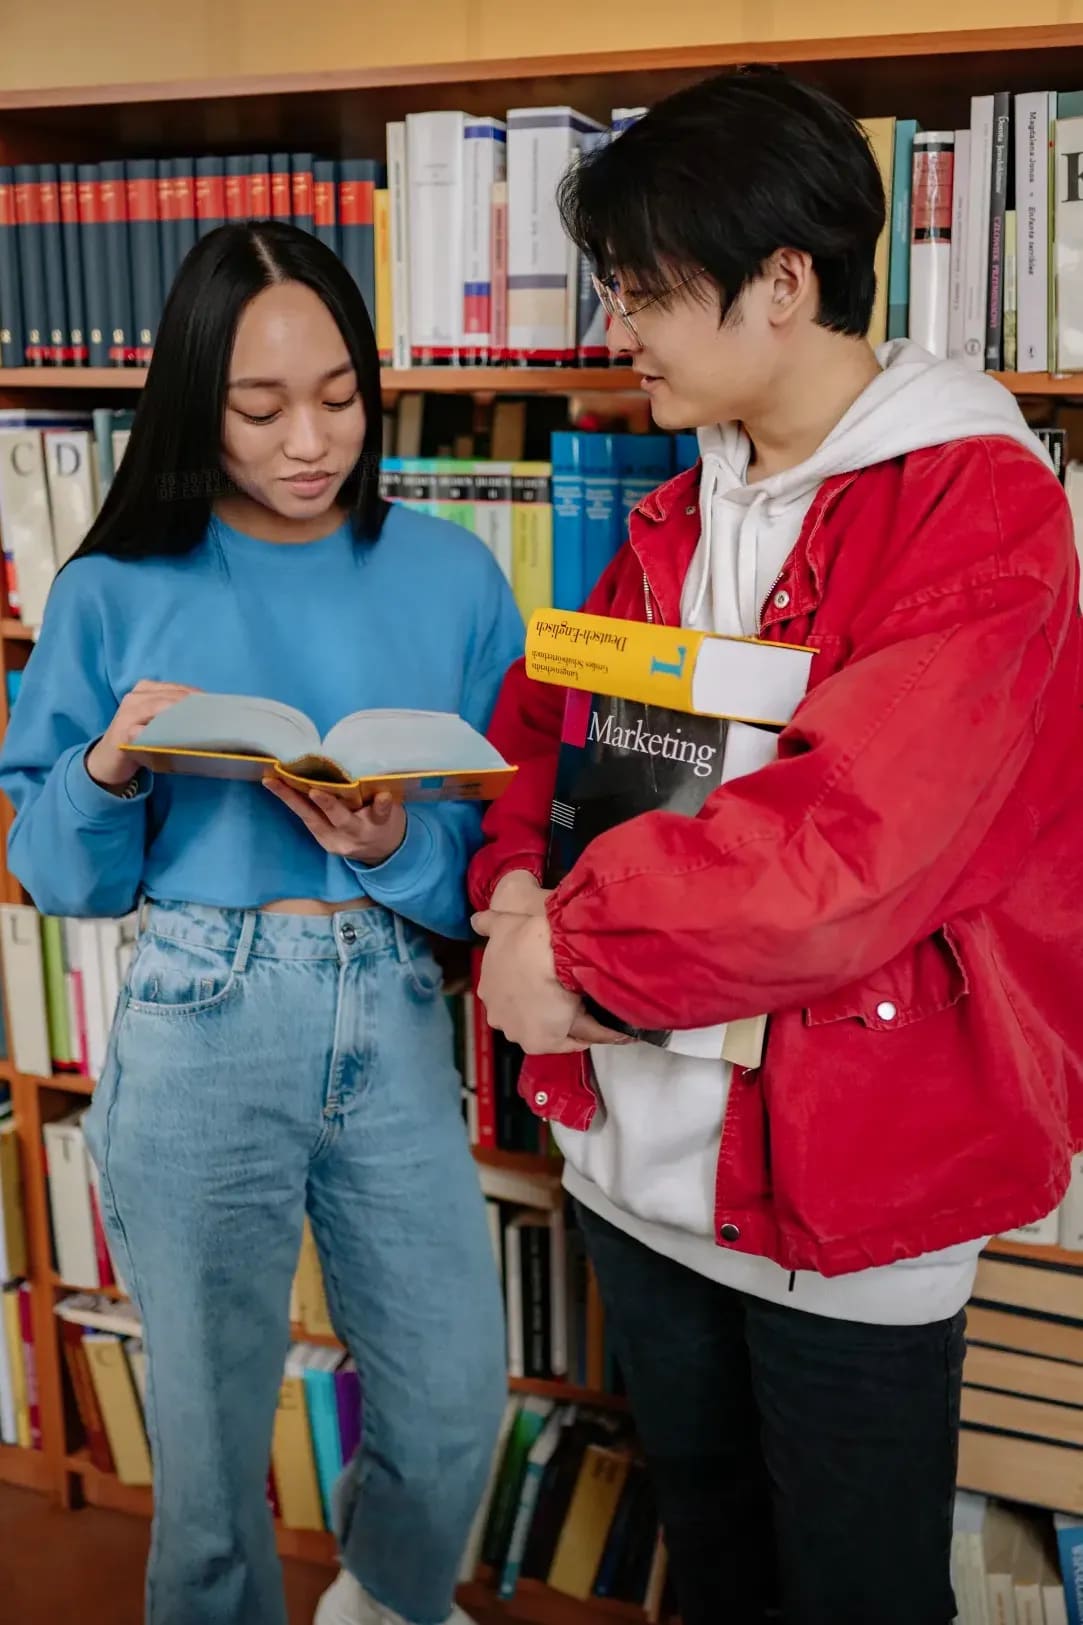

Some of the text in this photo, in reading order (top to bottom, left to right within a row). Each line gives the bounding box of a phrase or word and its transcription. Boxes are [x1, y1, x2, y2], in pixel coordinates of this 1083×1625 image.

[11, 443, 33, 476] C
[56, 443, 81, 476] D
[535, 620, 629, 652] Deutsch-Englisch
[587, 711, 717, 777] Marketing
